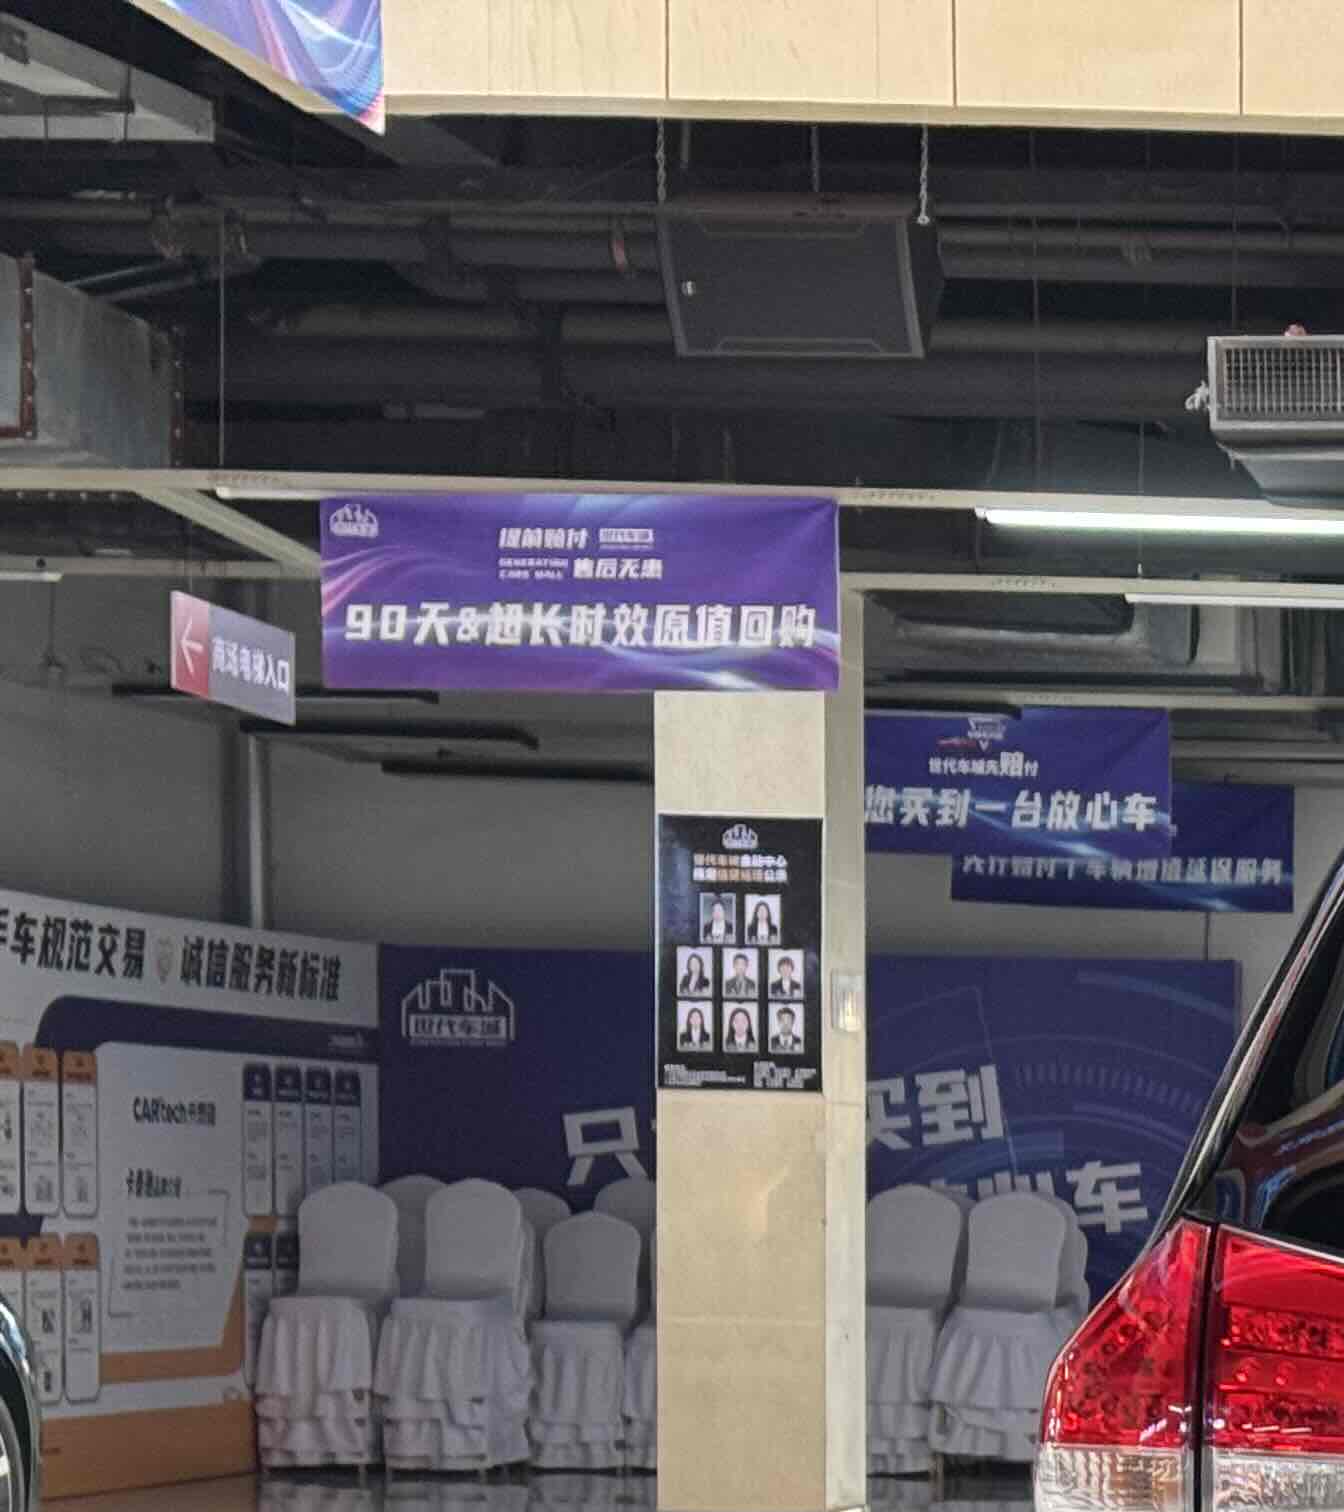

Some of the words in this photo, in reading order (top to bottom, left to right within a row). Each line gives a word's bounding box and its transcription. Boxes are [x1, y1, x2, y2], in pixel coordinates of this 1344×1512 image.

[344, 601, 818, 649] 90天&超长时效原值回购
[180, 935, 342, 1001] 诚信服务新标准
